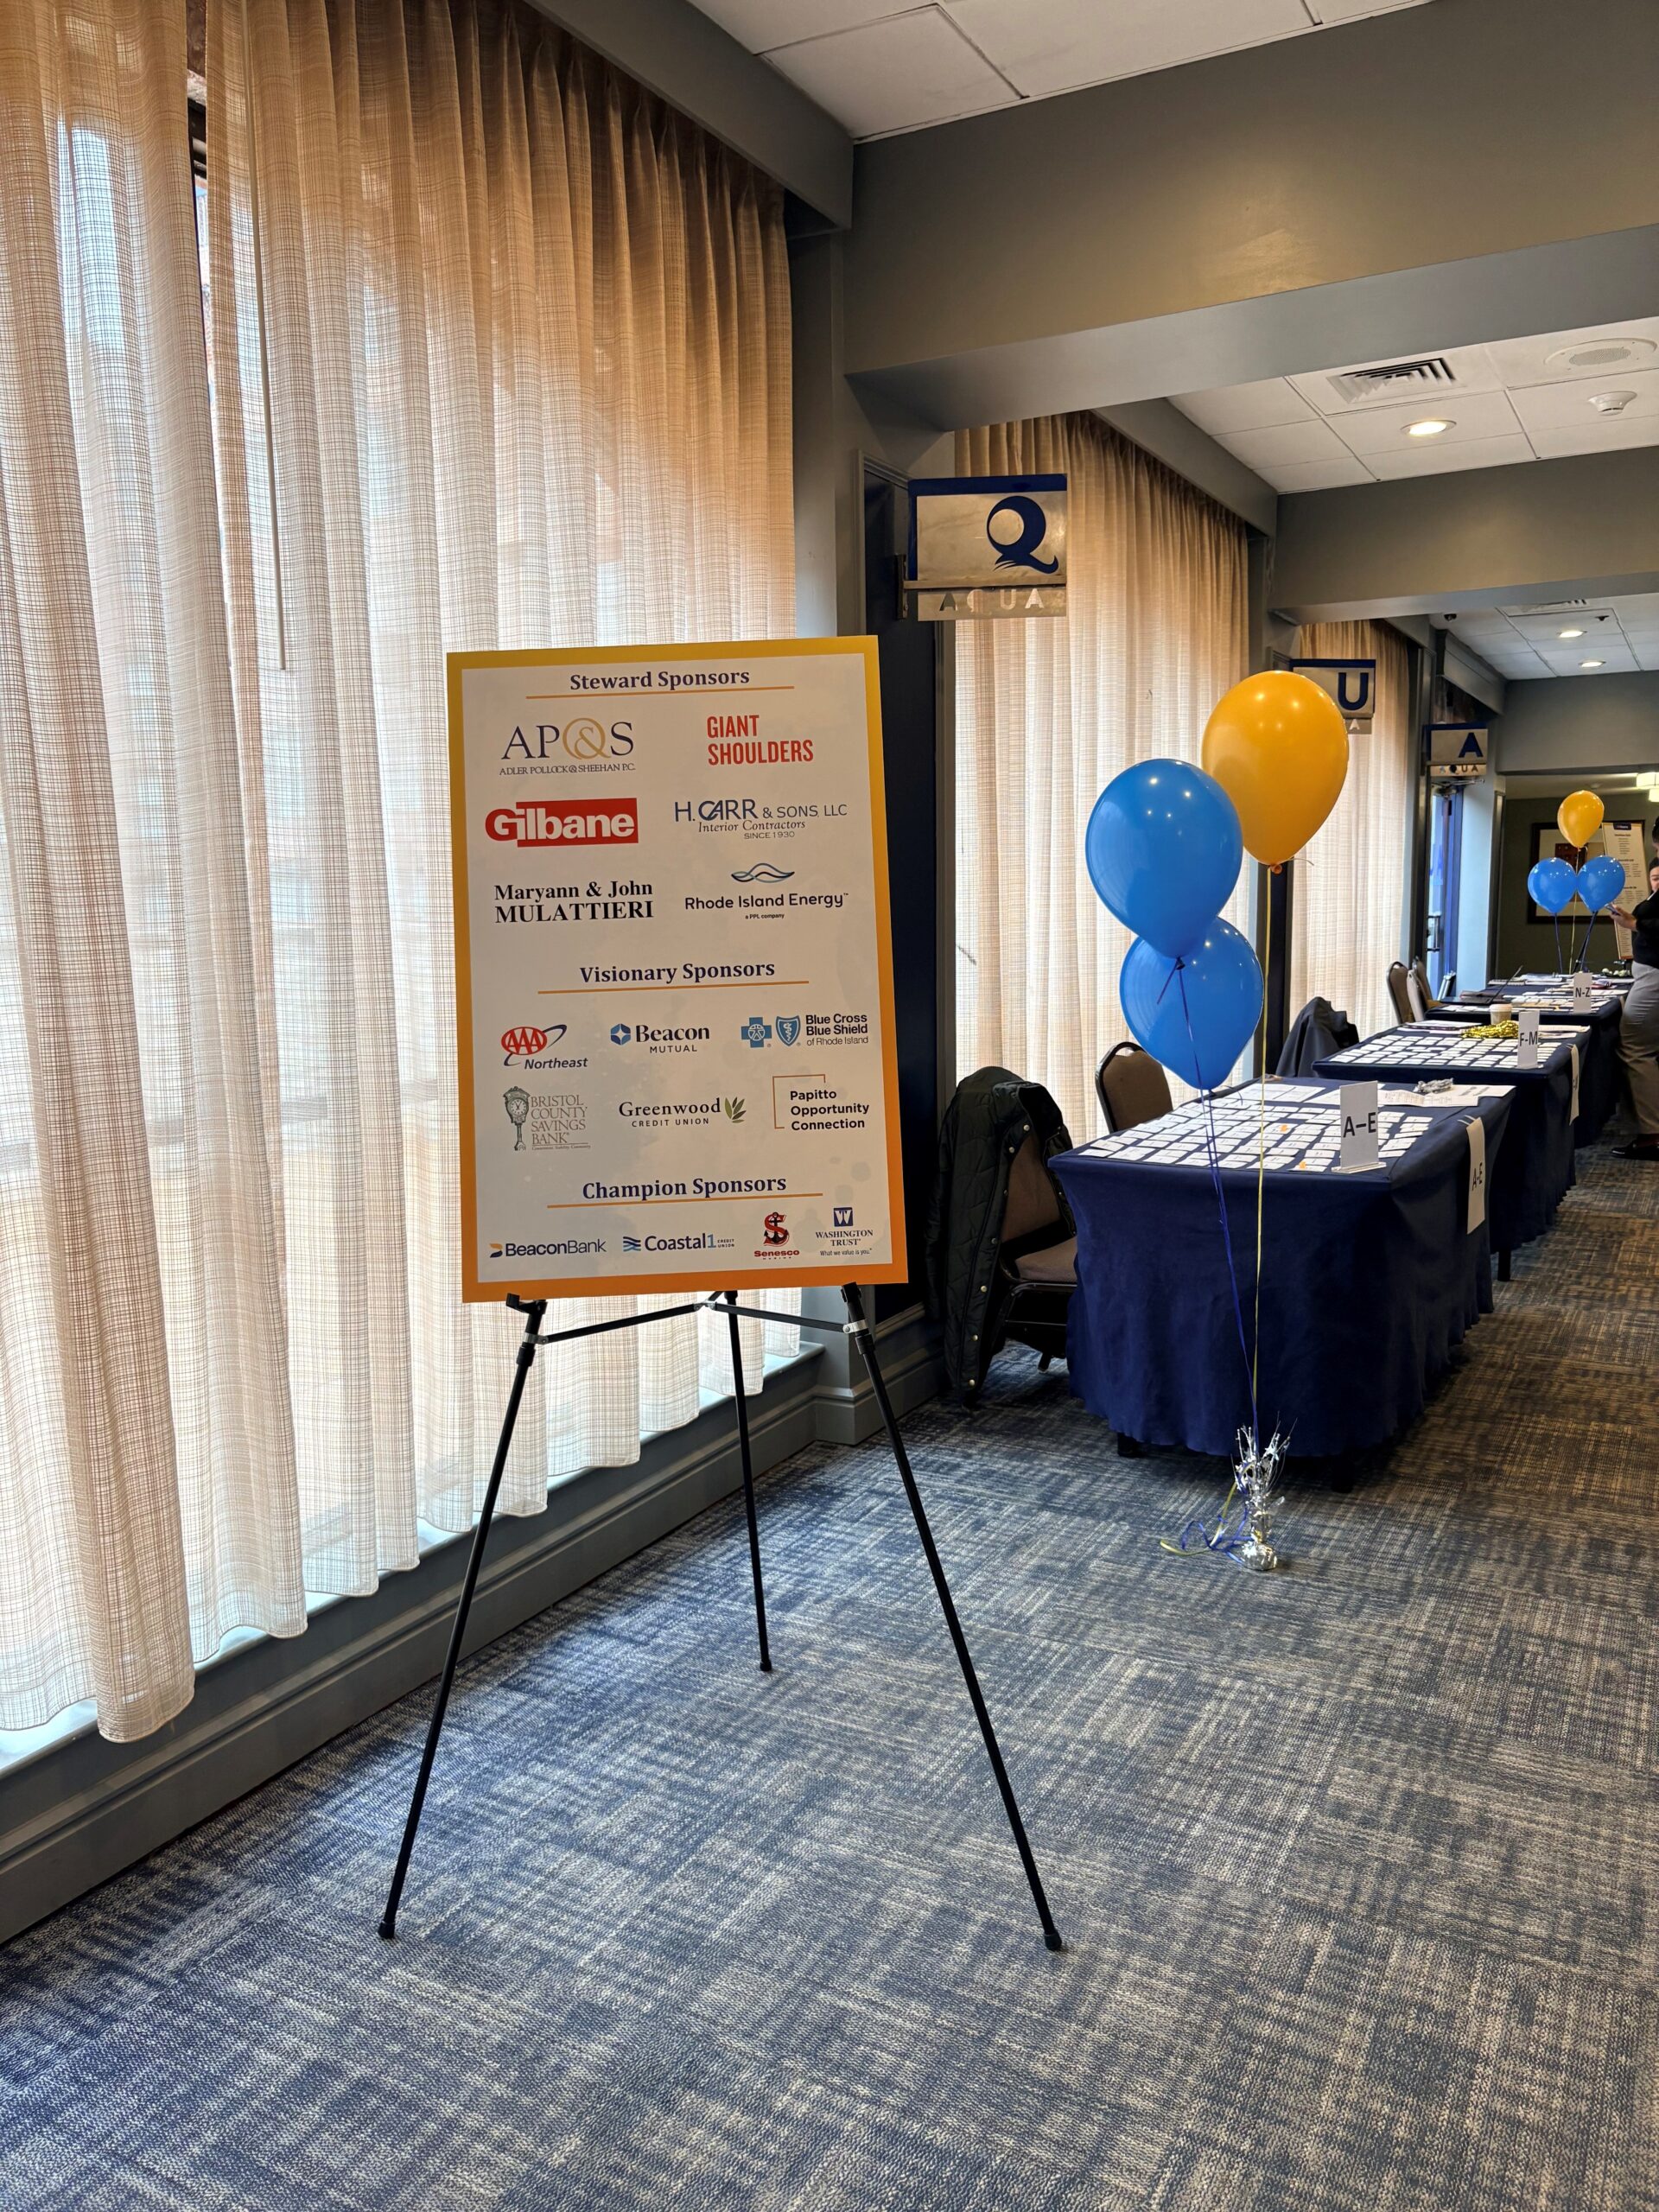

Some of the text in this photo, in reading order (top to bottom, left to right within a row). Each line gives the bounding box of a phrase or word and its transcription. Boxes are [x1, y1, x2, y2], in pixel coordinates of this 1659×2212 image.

[987, 495, 1058, 574] Q
[570, 671, 749, 690] Steward Sponsors
[1338, 672, 1369, 710] U
[707, 715, 760, 738] GIANT
[708, 740, 814, 766] SHOULDERS
[1459, 733, 1484, 758] A
[499, 766, 528, 775] ADLER
[675, 801, 696, 822] H.
[698, 798, 759, 821] CARR
[762, 807, 773, 818] &
[823, 804, 848, 817] LLC
[492, 807, 636, 841] Gilbane
[698, 819, 805, 833] Interior Contractors
[493, 880, 653, 903] Maryann & John
[685, 896, 734, 910] Rhode
[738, 893, 785, 907] Island
[495, 900, 654, 924] MULATTIERI
[580, 963, 775, 983] Visionary Sponsors
[1575, 988, 1591, 998] N-Z
[805, 1014, 868, 1025] Blue Cross
[635, 1025, 710, 1043] Beacon
[806, 1024, 868, 1036] Blue Shield
[504, 1027, 545, 1055] AAA
[806, 1036, 868, 1046] of Rhode Island
[1519, 1031, 1538, 1047] F-M
[650, 1045, 697, 1053] MUTUAL
[524, 1058, 588, 1070] Northeast
[531, 1094, 584, 1108] BRISTOL
[790, 1090, 837, 1102] Papitto
[531, 1107, 588, 1120] COUNTY
[619, 1097, 721, 1116] Greenwood
[791, 1103, 869, 1117] Opportunity
[531, 1119, 586, 1132] SAVINGS
[791, 1119, 865, 1131] Connection
[583, 1178, 786, 1200] Champion Sponsors
[645, 1233, 716, 1251] Coastal1
[815, 1230, 874, 1239] WASHINGTON
[505, 1238, 607, 1257] BeaconBank
